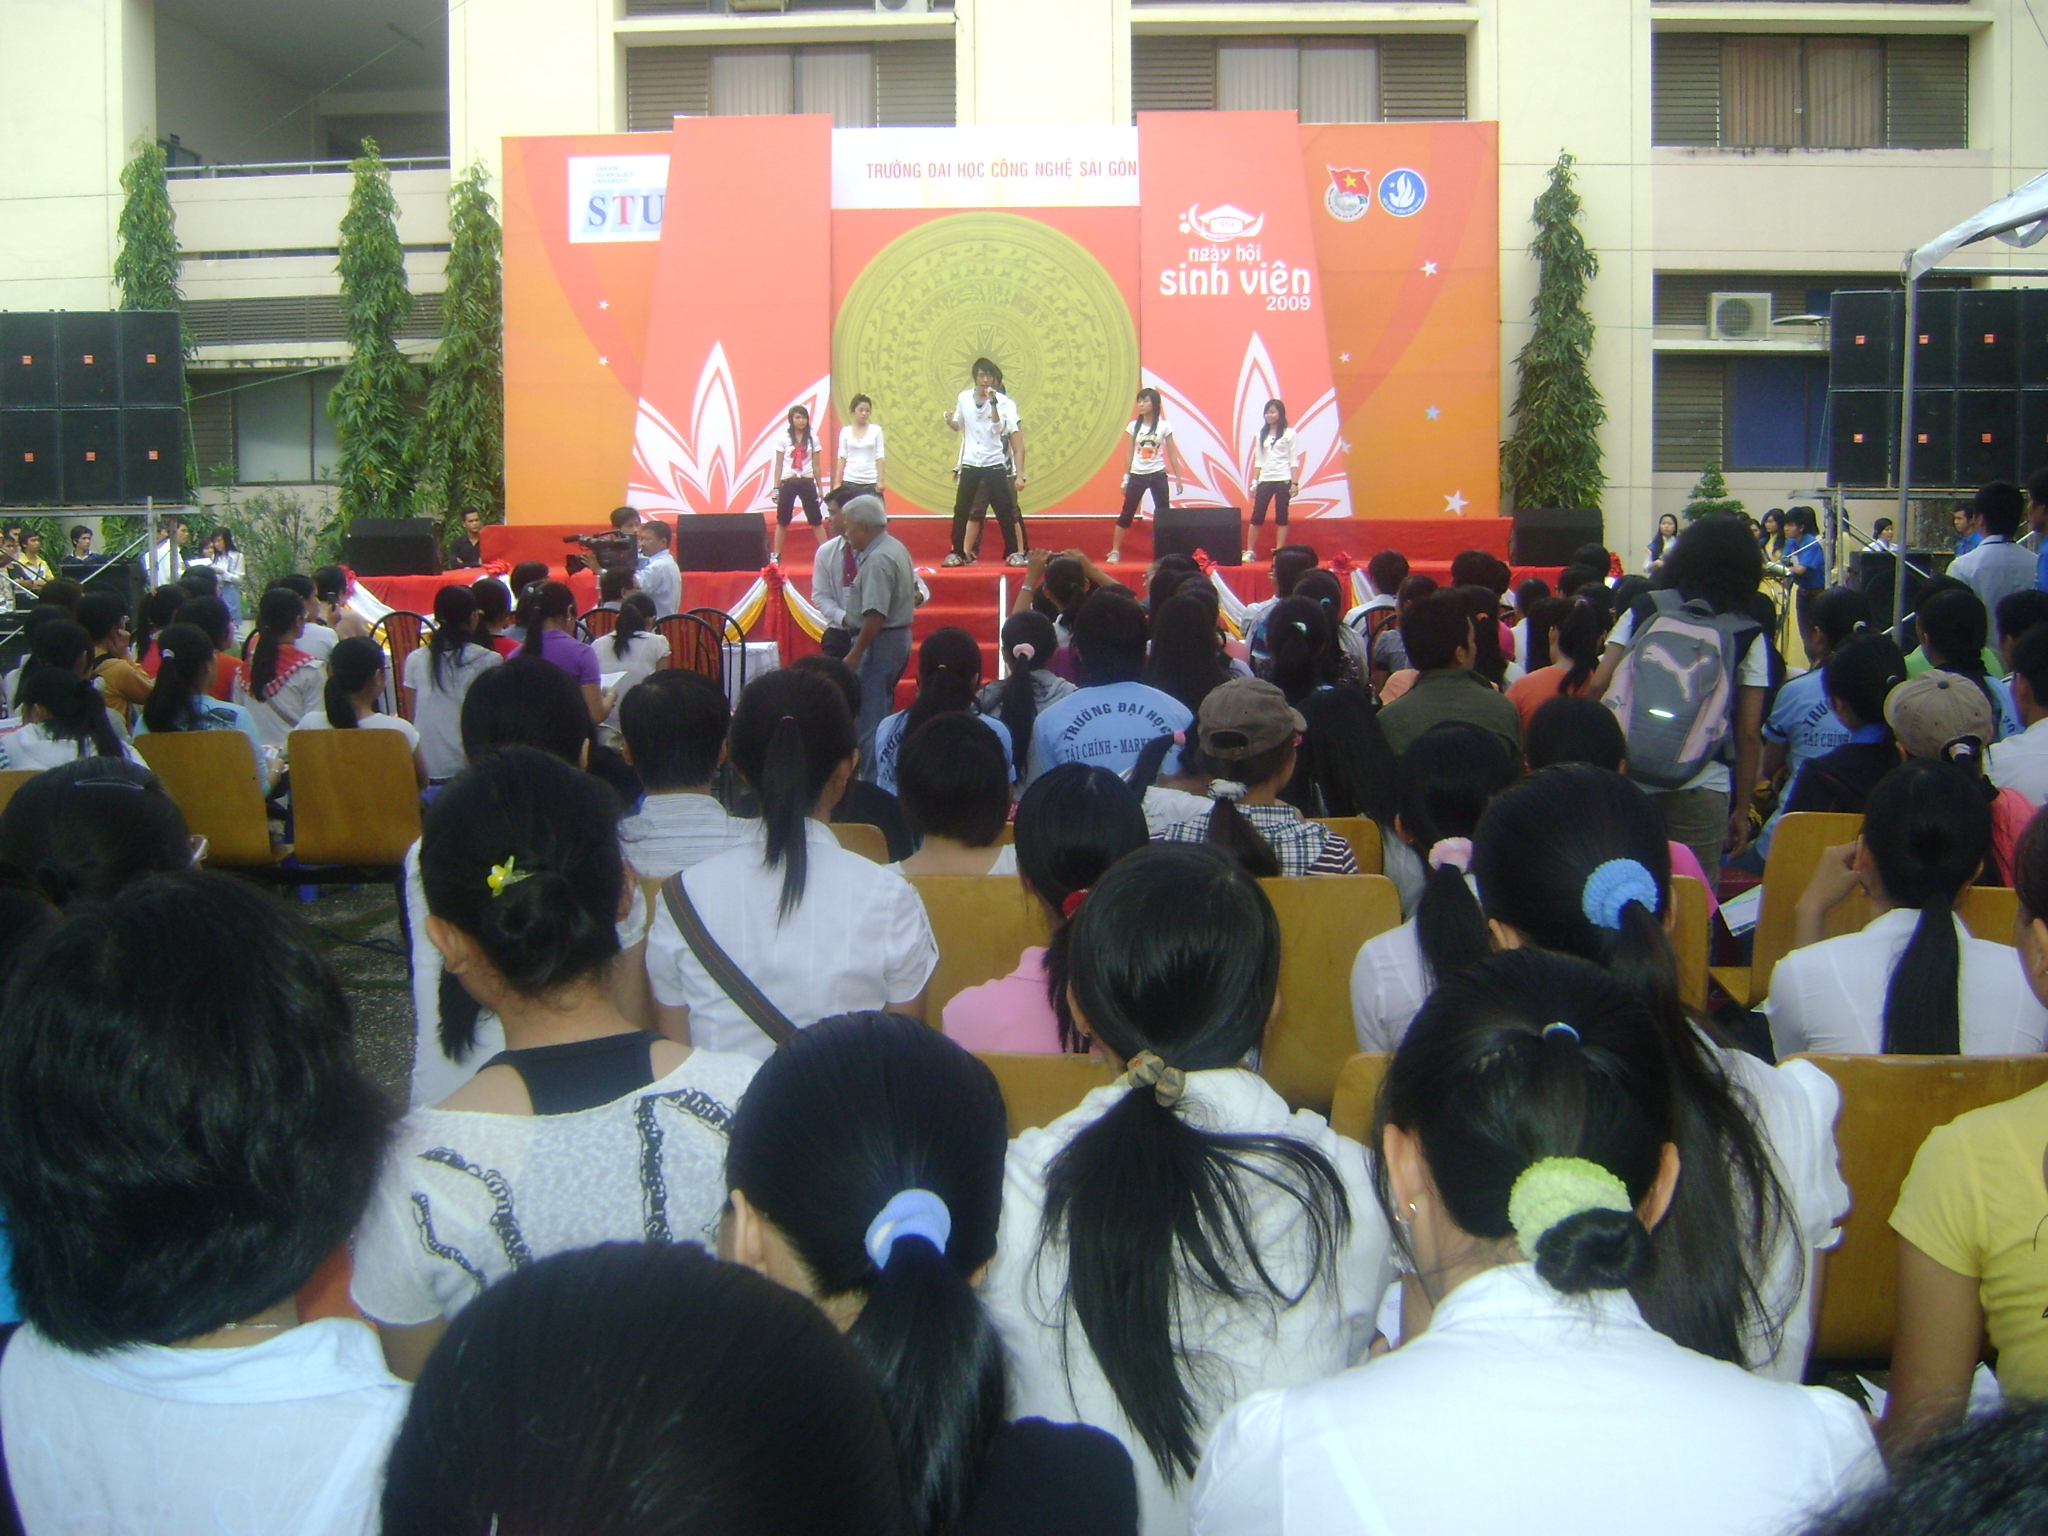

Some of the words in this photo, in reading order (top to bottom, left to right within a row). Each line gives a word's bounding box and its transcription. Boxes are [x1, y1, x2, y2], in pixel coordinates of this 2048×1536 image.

[866, 158, 922, 179] TRƯỜNG
[928, 162, 951, 181] ĐẠI
[957, 162, 985, 180] HỌC
[991, 158, 1028, 178] CÔNG
[1035, 157, 1073, 180] NGHỆ
[1080, 157, 1102, 177] SÀI
[1108, 157, 1137, 177] GÒN
[588, 194, 666, 227] STU
[1188, 244, 1231, 262] ngày
[1236, 244, 1261, 265] hội
[1160, 262, 1229, 295] sinh
[1239, 260, 1310, 295] viên
[1266, 296, 1311, 311] 2009
[1118, 702, 1145, 717] ĐẠI
[1081, 737, 1112, 758] CHÍNH
